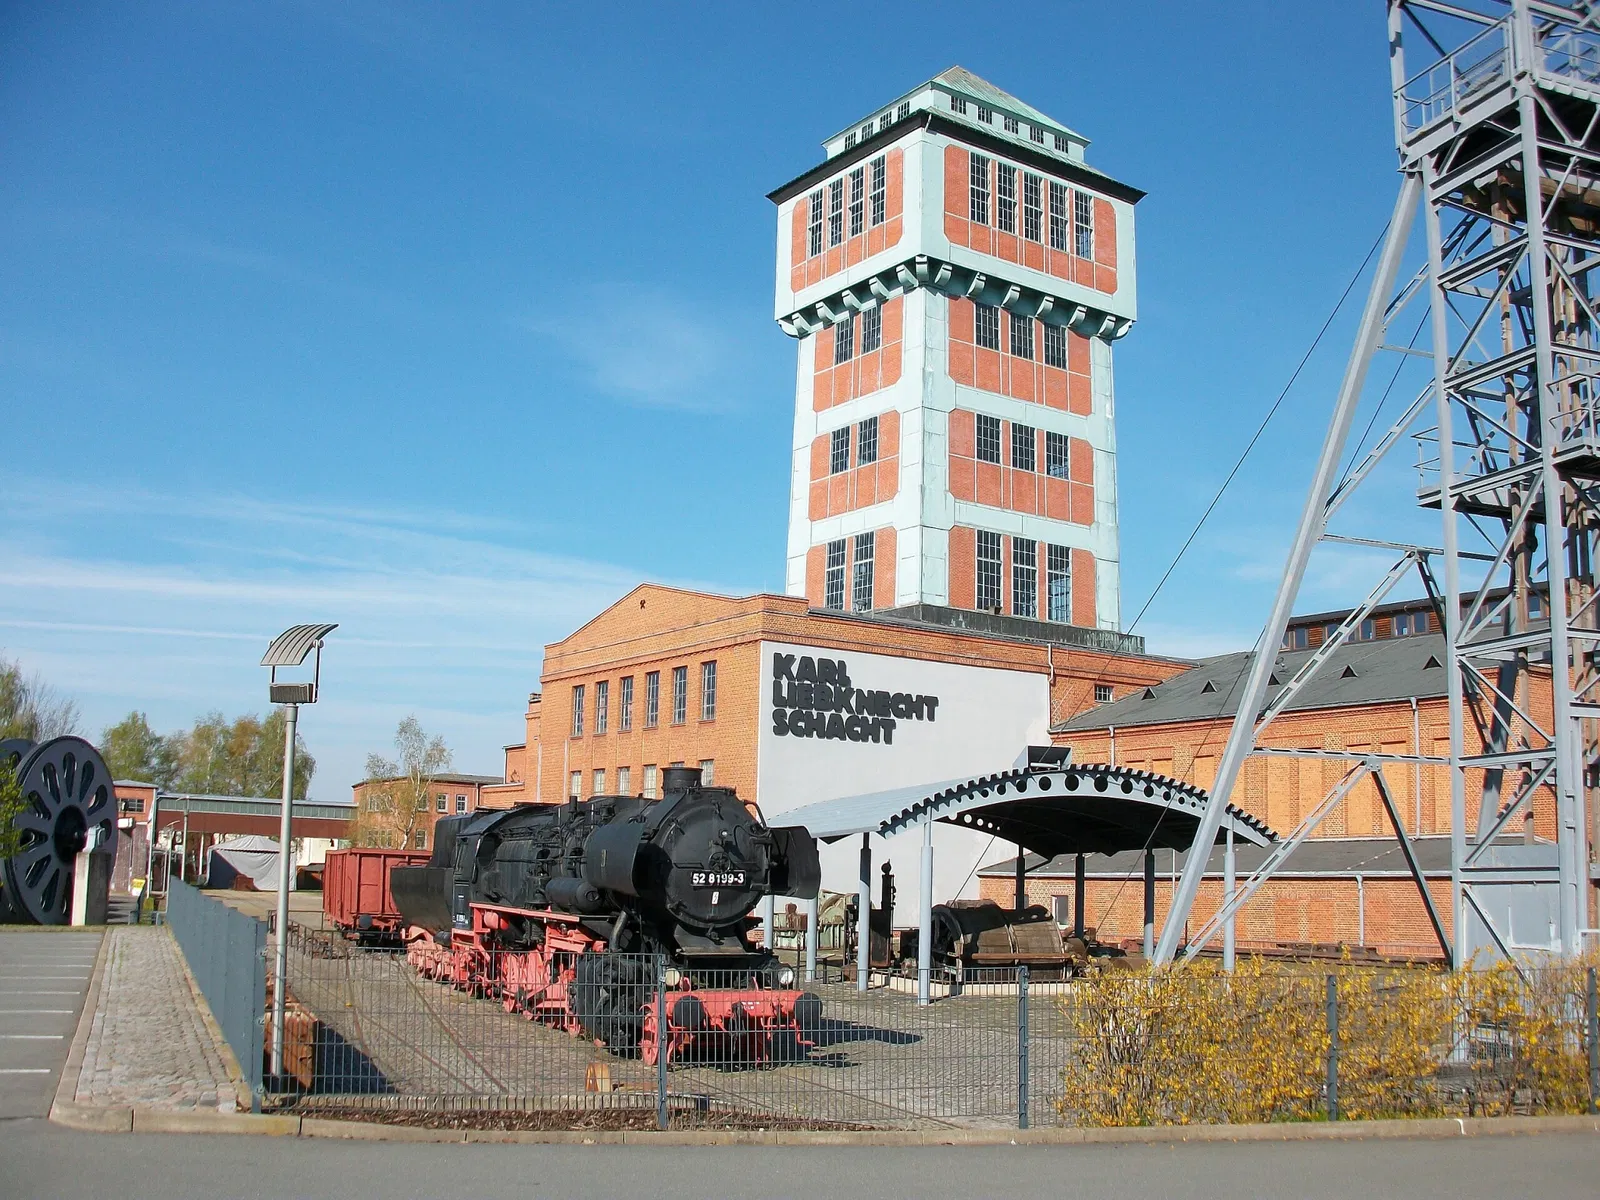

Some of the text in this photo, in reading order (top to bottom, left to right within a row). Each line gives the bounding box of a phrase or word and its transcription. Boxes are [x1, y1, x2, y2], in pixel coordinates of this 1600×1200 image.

[773, 652, 851, 687] KARL
[772, 680, 939, 721] LIEBKNECHT
[772, 708, 896, 744] SCHACHT
[692, 873, 744, 884] 52 8199-3
